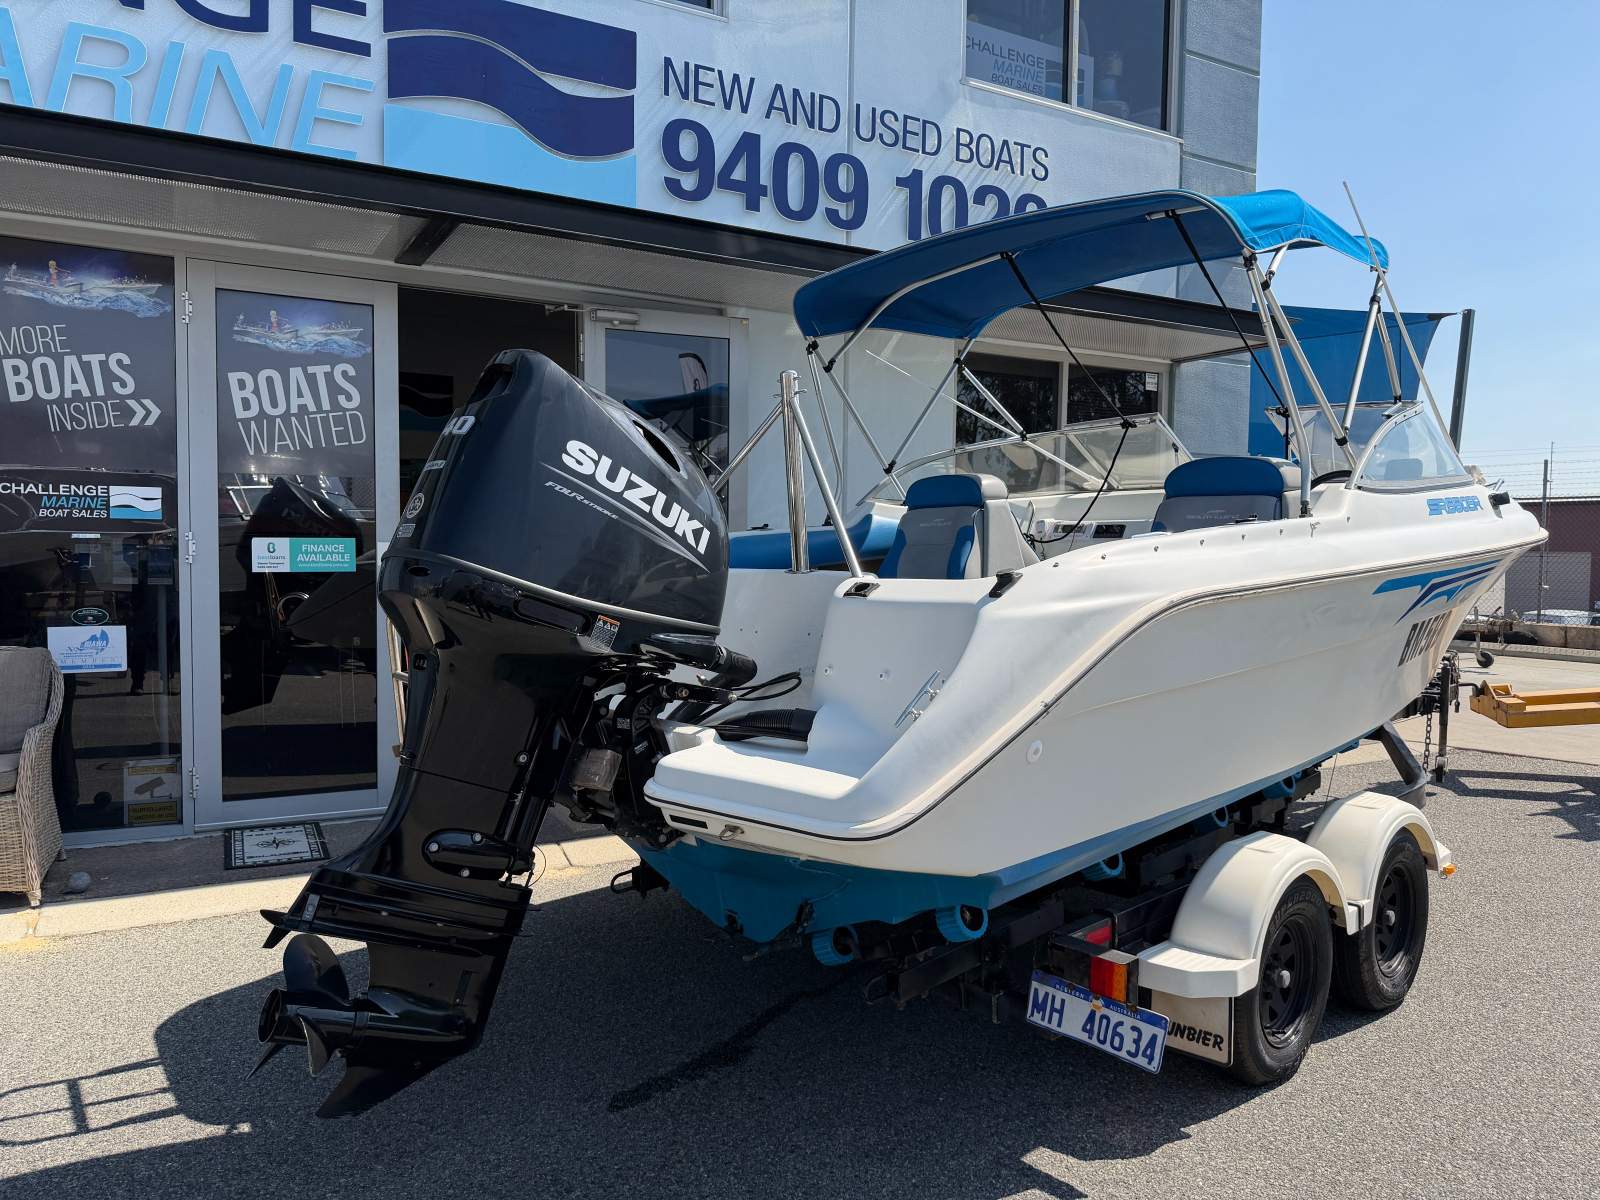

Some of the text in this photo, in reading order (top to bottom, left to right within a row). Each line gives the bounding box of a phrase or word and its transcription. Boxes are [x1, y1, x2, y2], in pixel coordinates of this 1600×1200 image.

[992, 73, 1043, 96] BOAT SALES
[993, 59, 1044, 82] MARINE
[662, 56, 1050, 182] NEW AND USED BOATS
[661, 118, 1048, 242] 9409 102
[0, 324, 71, 355] MORE
[2, 352, 136, 402] BOATS
[228, 363, 361, 419] BOATS
[47, 400, 125, 432] INSIDE
[237, 410, 367, 455] WANTED
[0, 483, 108, 496] CHALLENGE
[41, 495, 108, 509] MARINE
[561, 440, 711, 554] SUZUKI
[39, 508, 108, 518] BOAT SALES
[297, 554, 351, 562] AVAILABLE
[302, 544, 345, 552] FINANCE
[1030, 988, 1159, 1066] MH 40634
[1109, 1005, 1142, 1020] AUSTRALIA
